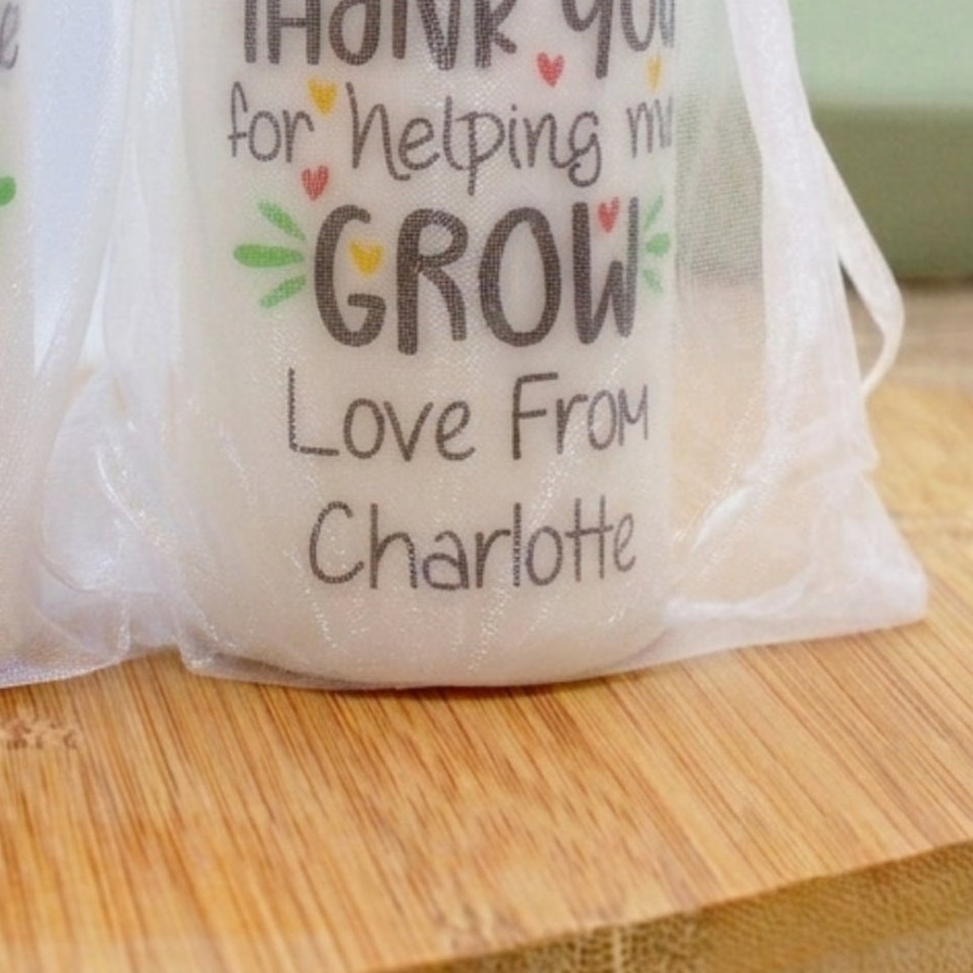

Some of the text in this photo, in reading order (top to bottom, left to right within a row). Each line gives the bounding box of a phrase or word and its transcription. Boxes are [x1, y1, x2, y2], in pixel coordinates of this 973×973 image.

[227, 80, 315, 163] for
[346, 80, 603, 196] helping
[313, 196, 639, 356] GROW
[287, 367, 649, 461] Love From
[308, 494, 637, 591] Charlotte
